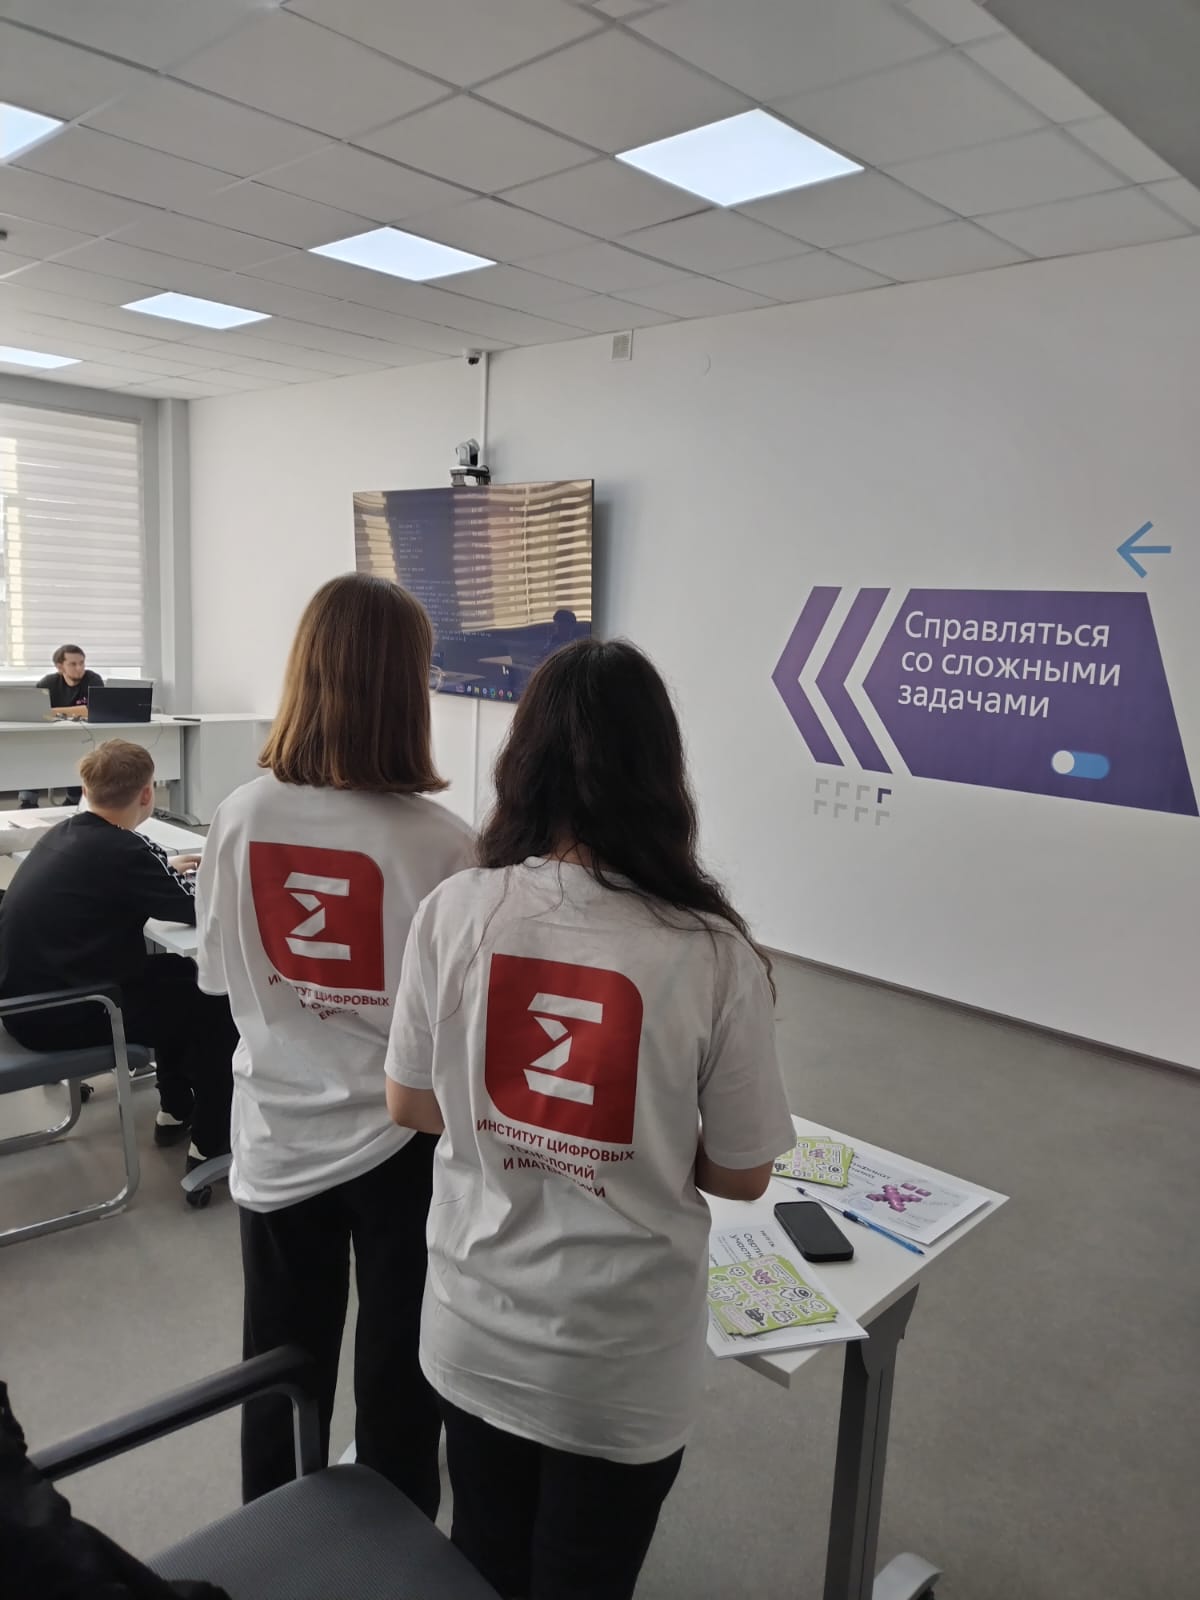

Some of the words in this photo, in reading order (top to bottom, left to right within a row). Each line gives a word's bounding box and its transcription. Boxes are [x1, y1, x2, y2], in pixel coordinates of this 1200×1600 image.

[905, 610, 1110, 648] Справляться
[901, 651, 933, 673] со
[941, 652, 1121, 687] сложными
[897, 684, 1051, 719] задачами
[314, 991, 390, 1007] ЦИФРОВЫХ
[476, 1119, 545, 1147] ИНСТИТУТ
[546, 1137, 635, 1163] ЦИФРОВЫХ
[503, 1157, 514, 1171] И
